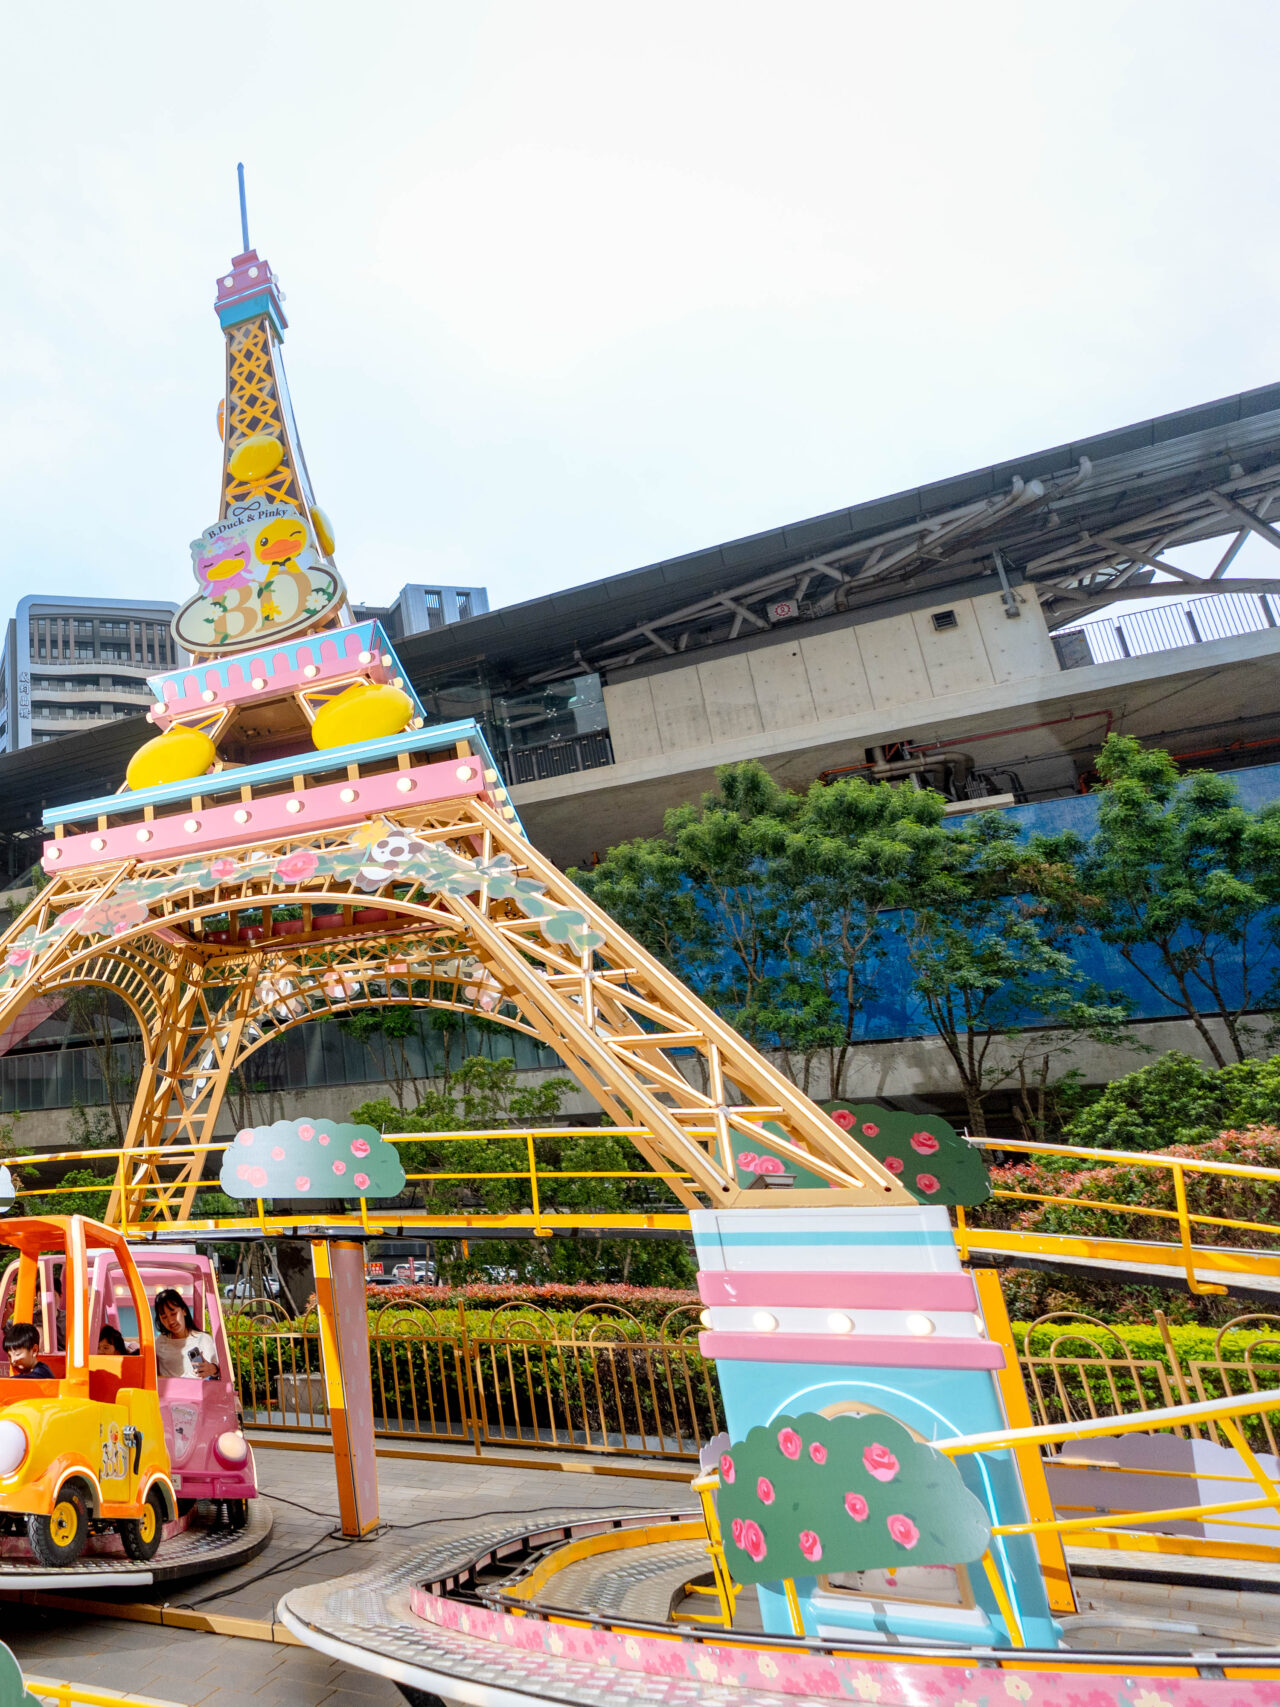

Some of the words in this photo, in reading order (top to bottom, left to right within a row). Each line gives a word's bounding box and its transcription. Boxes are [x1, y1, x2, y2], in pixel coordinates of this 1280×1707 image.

[208, 517, 245, 539] B.Duck
[247, 513, 255, 522] &
[258, 507, 289, 519] Pinky
